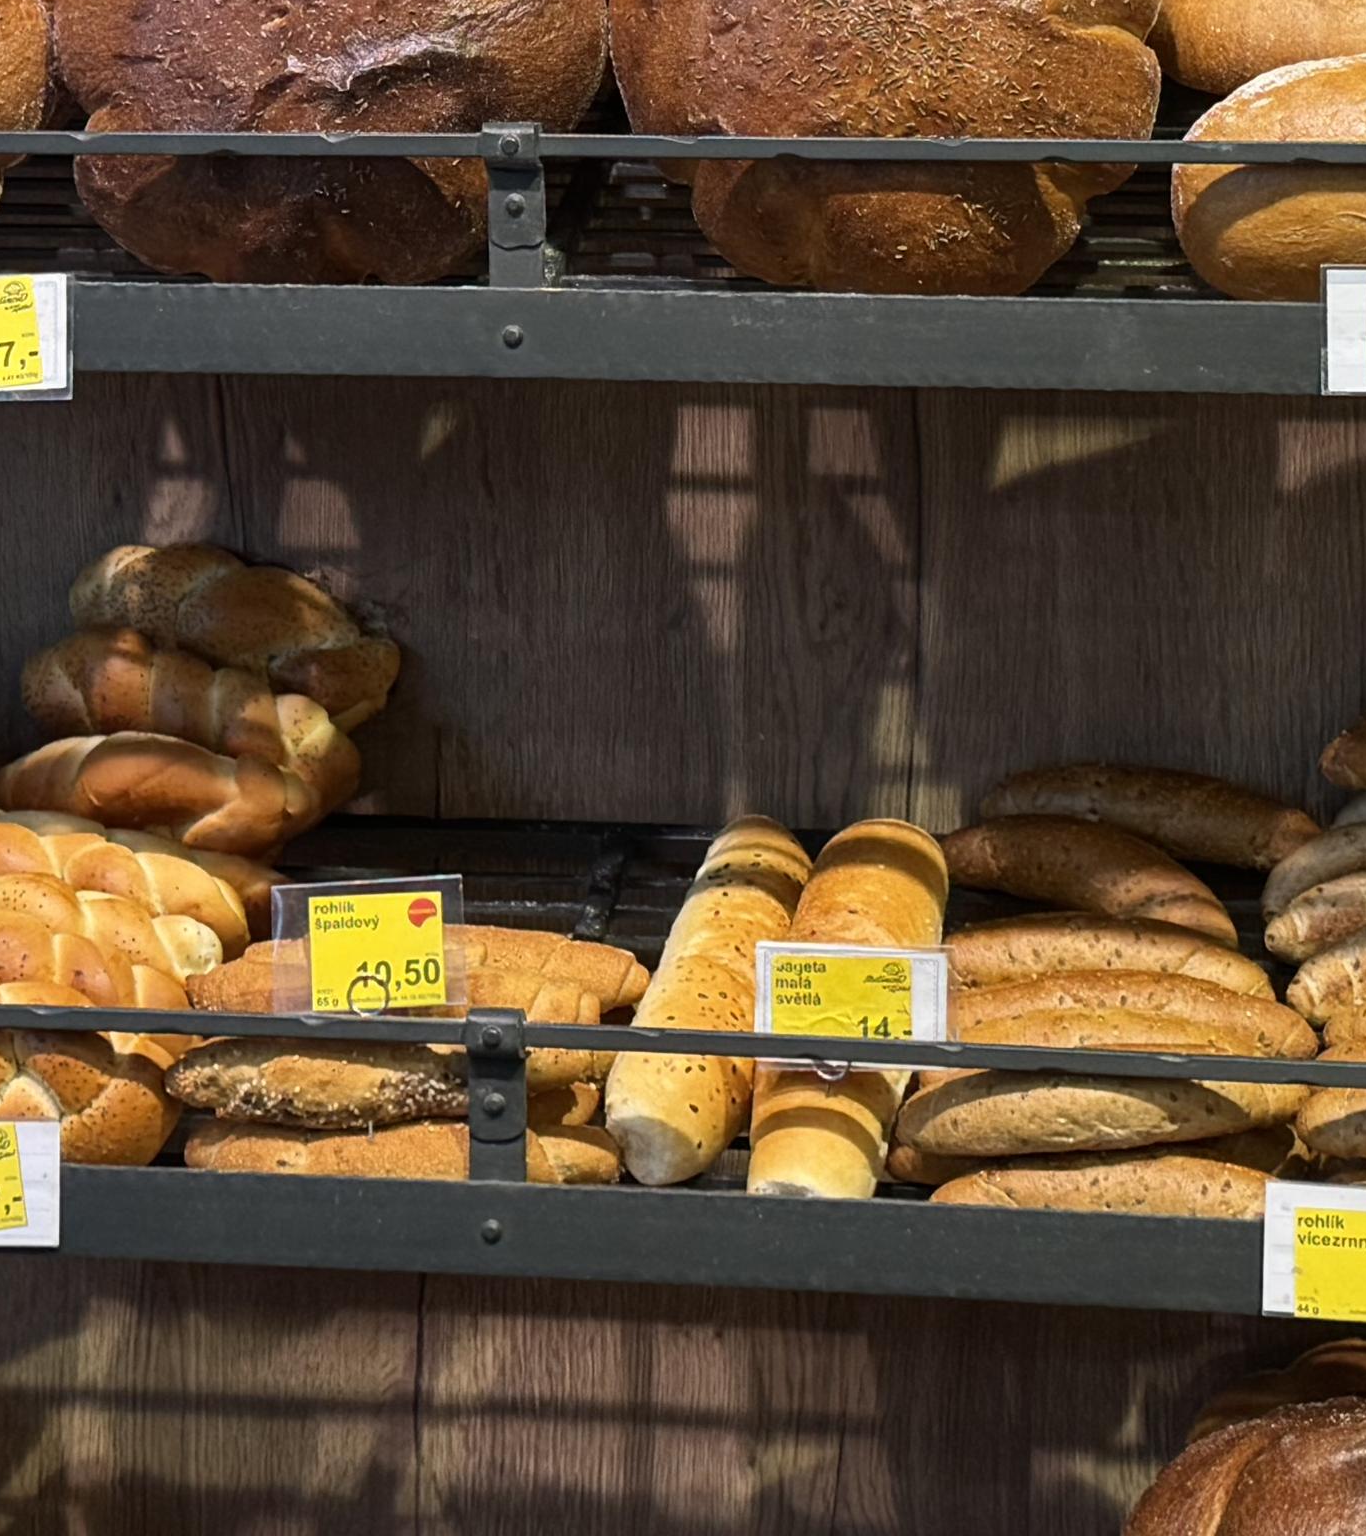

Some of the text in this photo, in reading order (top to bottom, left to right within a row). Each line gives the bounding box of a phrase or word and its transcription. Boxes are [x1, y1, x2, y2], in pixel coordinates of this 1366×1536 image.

[314, 901, 355, 915] rohlík
[314, 914, 380, 932] špaldový
[356, 958, 442, 992] 10,50
[775, 975, 812, 990] malá
[775, 992, 821, 1006] světlá
[1297, 1214, 1345, 1230] rohlík
